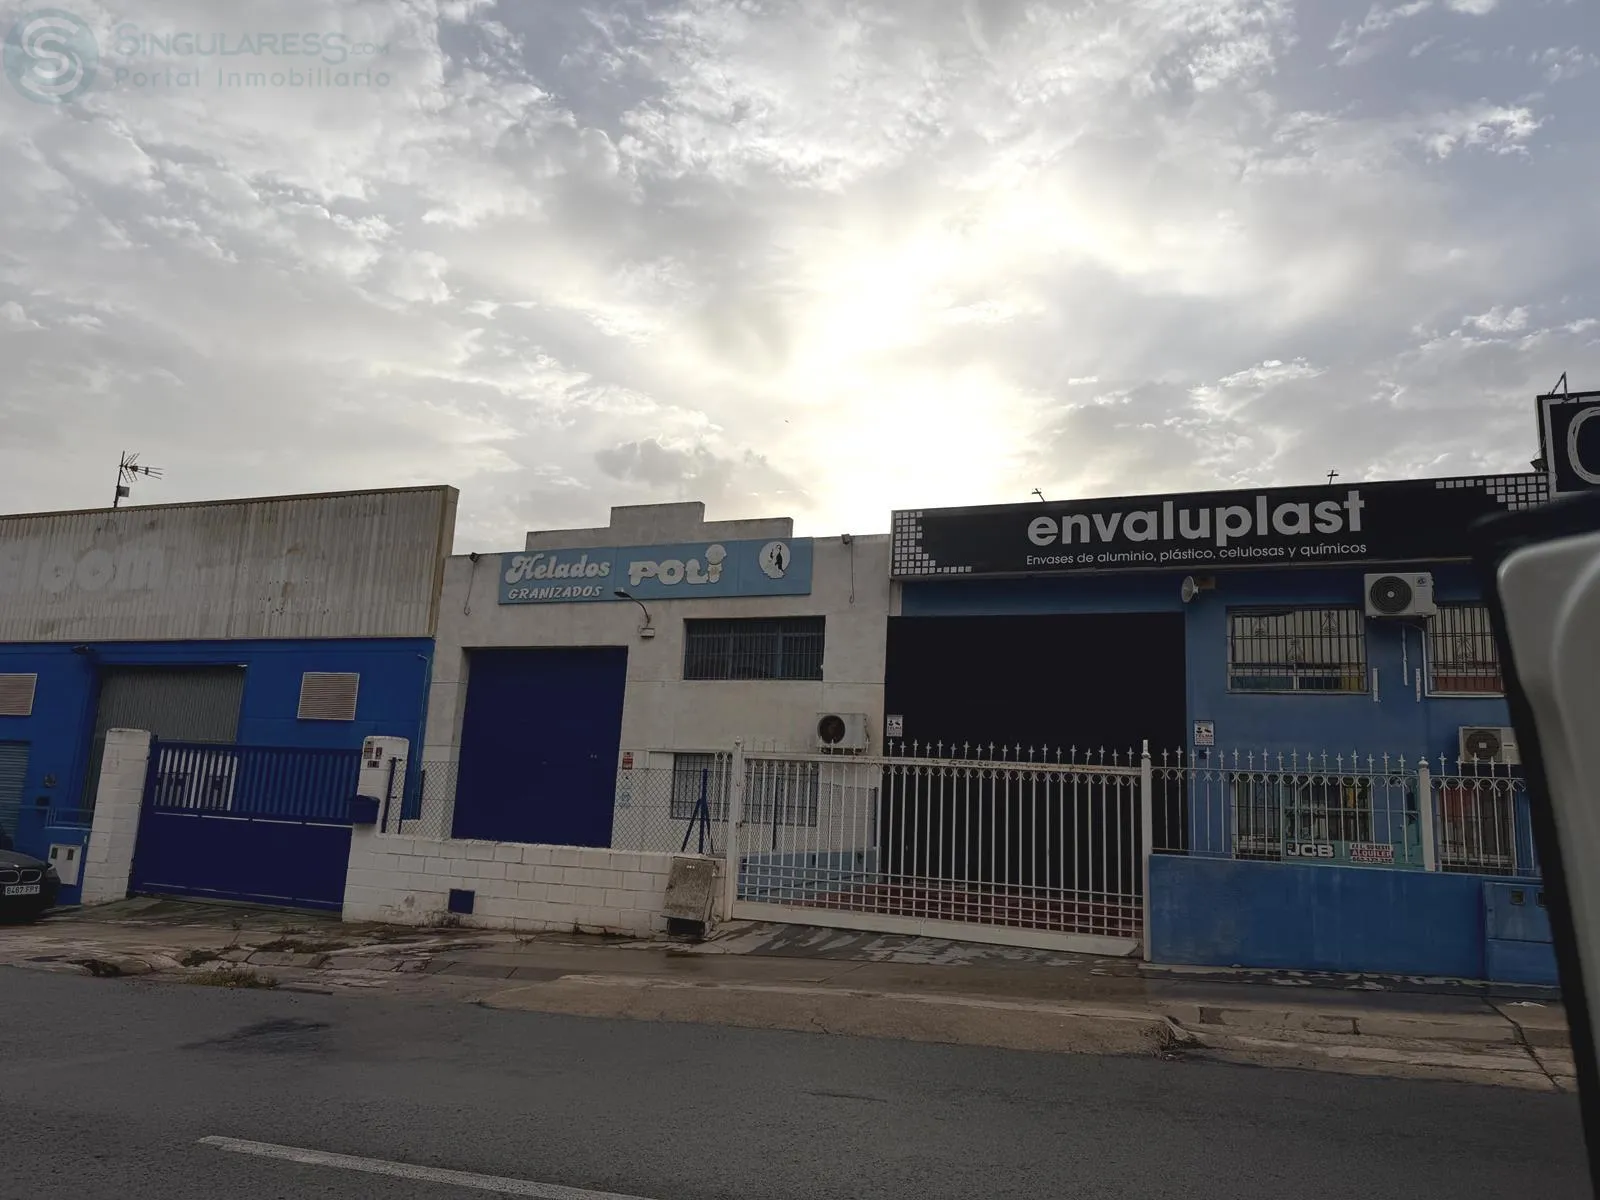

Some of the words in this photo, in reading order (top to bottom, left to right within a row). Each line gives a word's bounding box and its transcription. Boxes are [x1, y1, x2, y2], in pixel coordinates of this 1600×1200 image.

[1027, 490, 1365, 547] envaluplast
[1026, 555, 1074, 565] Envases
[1077, 553, 1094, 563] de
[1098, 550, 1157, 562] aluminio,
[1160, 548, 1216, 562] plástico,
[1219, 546, 1285, 558] celulosas
[1288, 548, 1297, 558] y
[1300, 543, 1367, 557] químicos
[505, 554, 610, 584] Helados
[508, 586, 603, 600] GRANIZADOS
[1286, 844, 1333, 858] JCB
